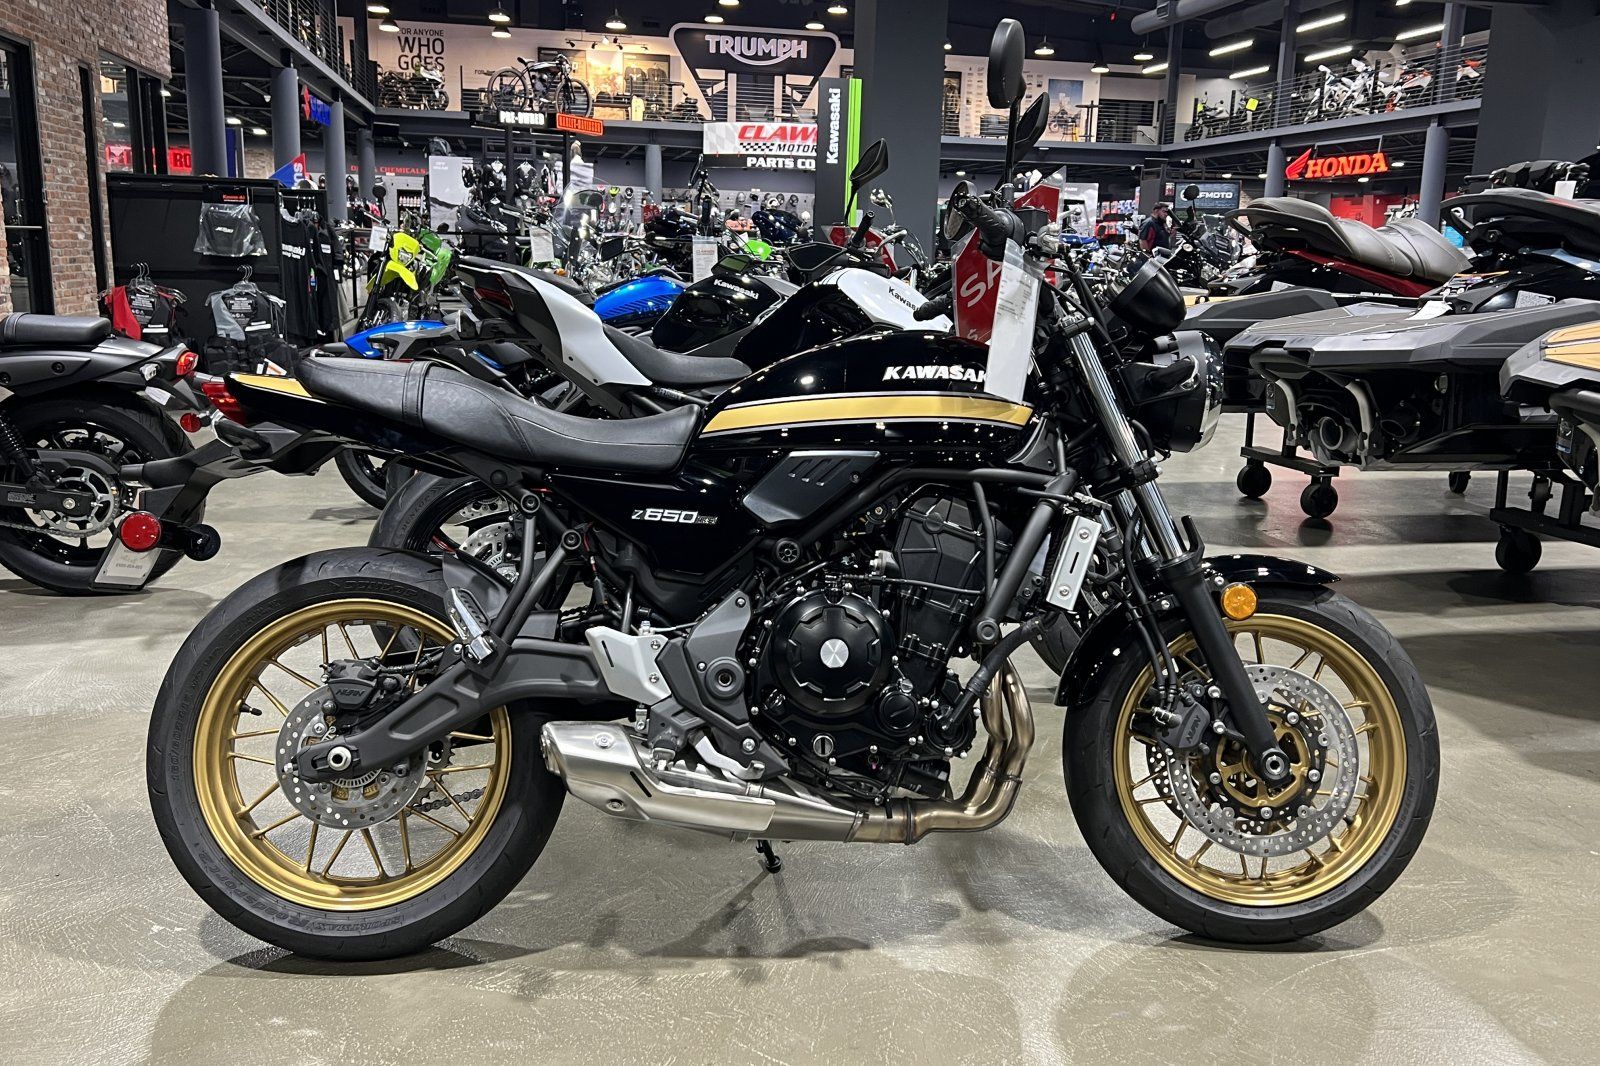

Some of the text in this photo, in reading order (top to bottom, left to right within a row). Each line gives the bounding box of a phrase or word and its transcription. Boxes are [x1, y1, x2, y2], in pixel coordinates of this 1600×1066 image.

[397, 36, 445, 55] WHO
[705, 34, 808, 65] TRIUMPH
[398, 55, 445, 72] GOES
[826, 88, 841, 164] Kawasaki
[380, 166, 426, 174] CHEMICALS
[746, 157, 795, 168] PARTS
[1304, 152, 1388, 179] HONDA
[713, 279, 760, 300] Kawasaki
